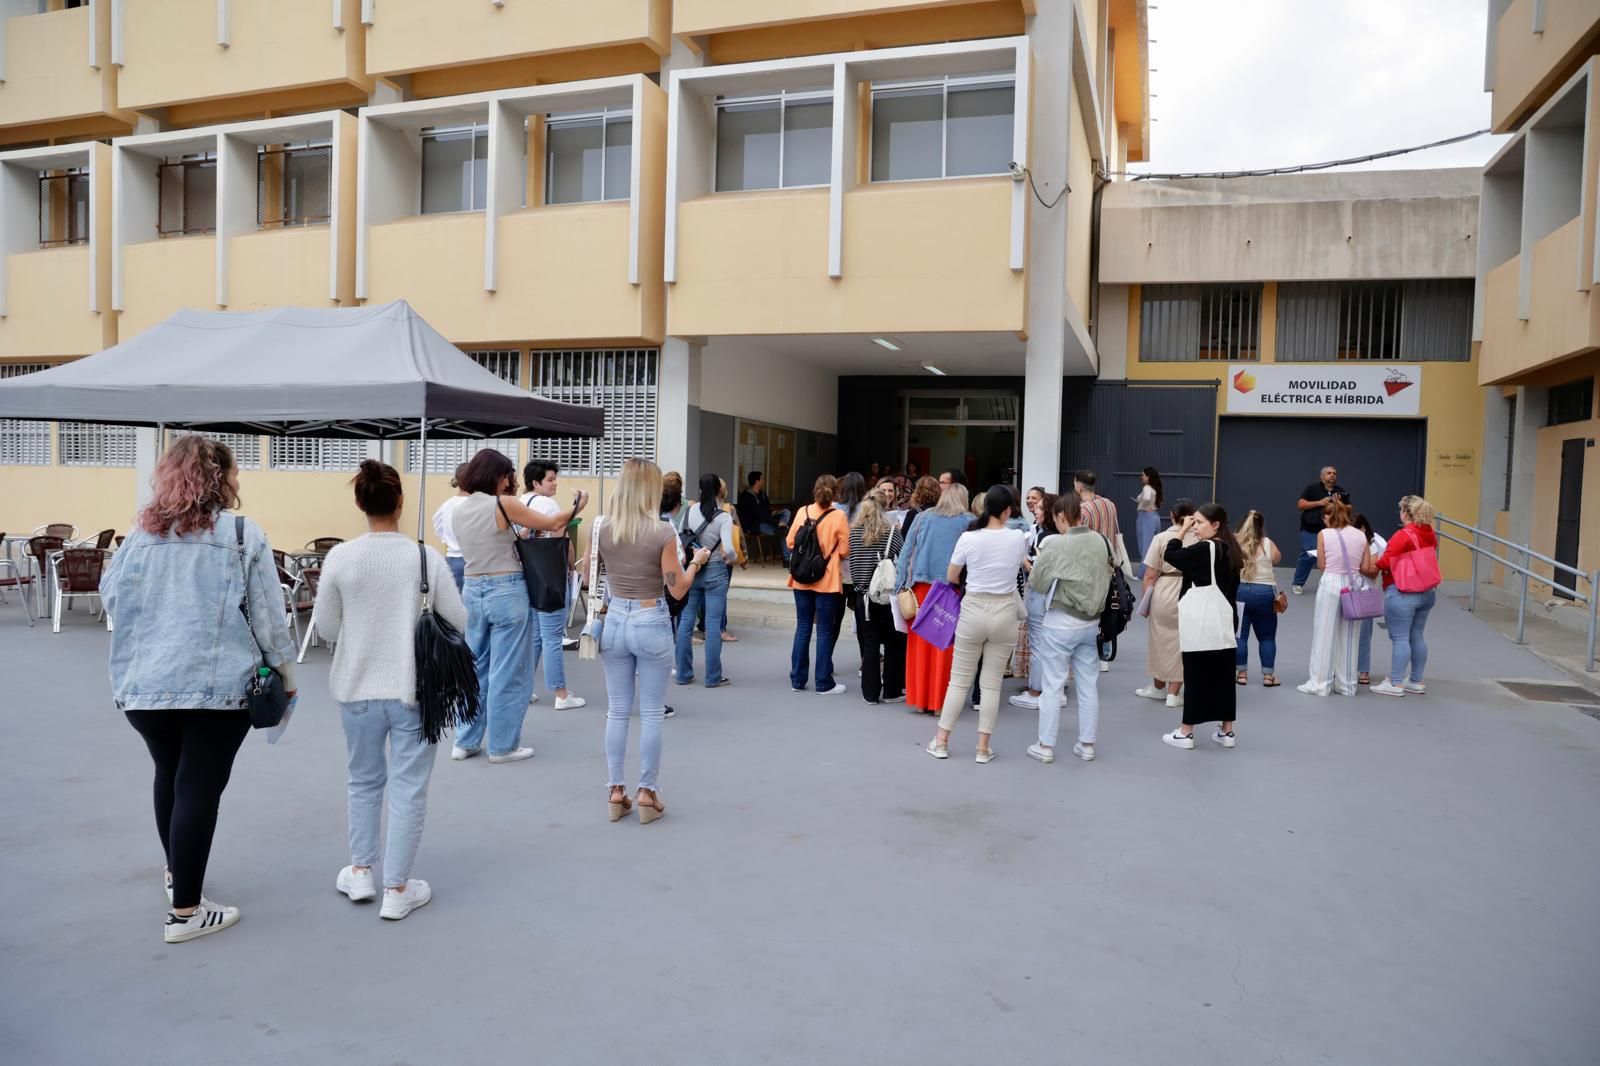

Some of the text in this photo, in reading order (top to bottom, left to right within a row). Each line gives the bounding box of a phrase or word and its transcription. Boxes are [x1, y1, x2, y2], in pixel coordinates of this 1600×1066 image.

[1288, 380, 1357, 390] MOVILIDAD
[1261, 392, 1384, 405] ELÉCTRICA E HÍBRIDA
